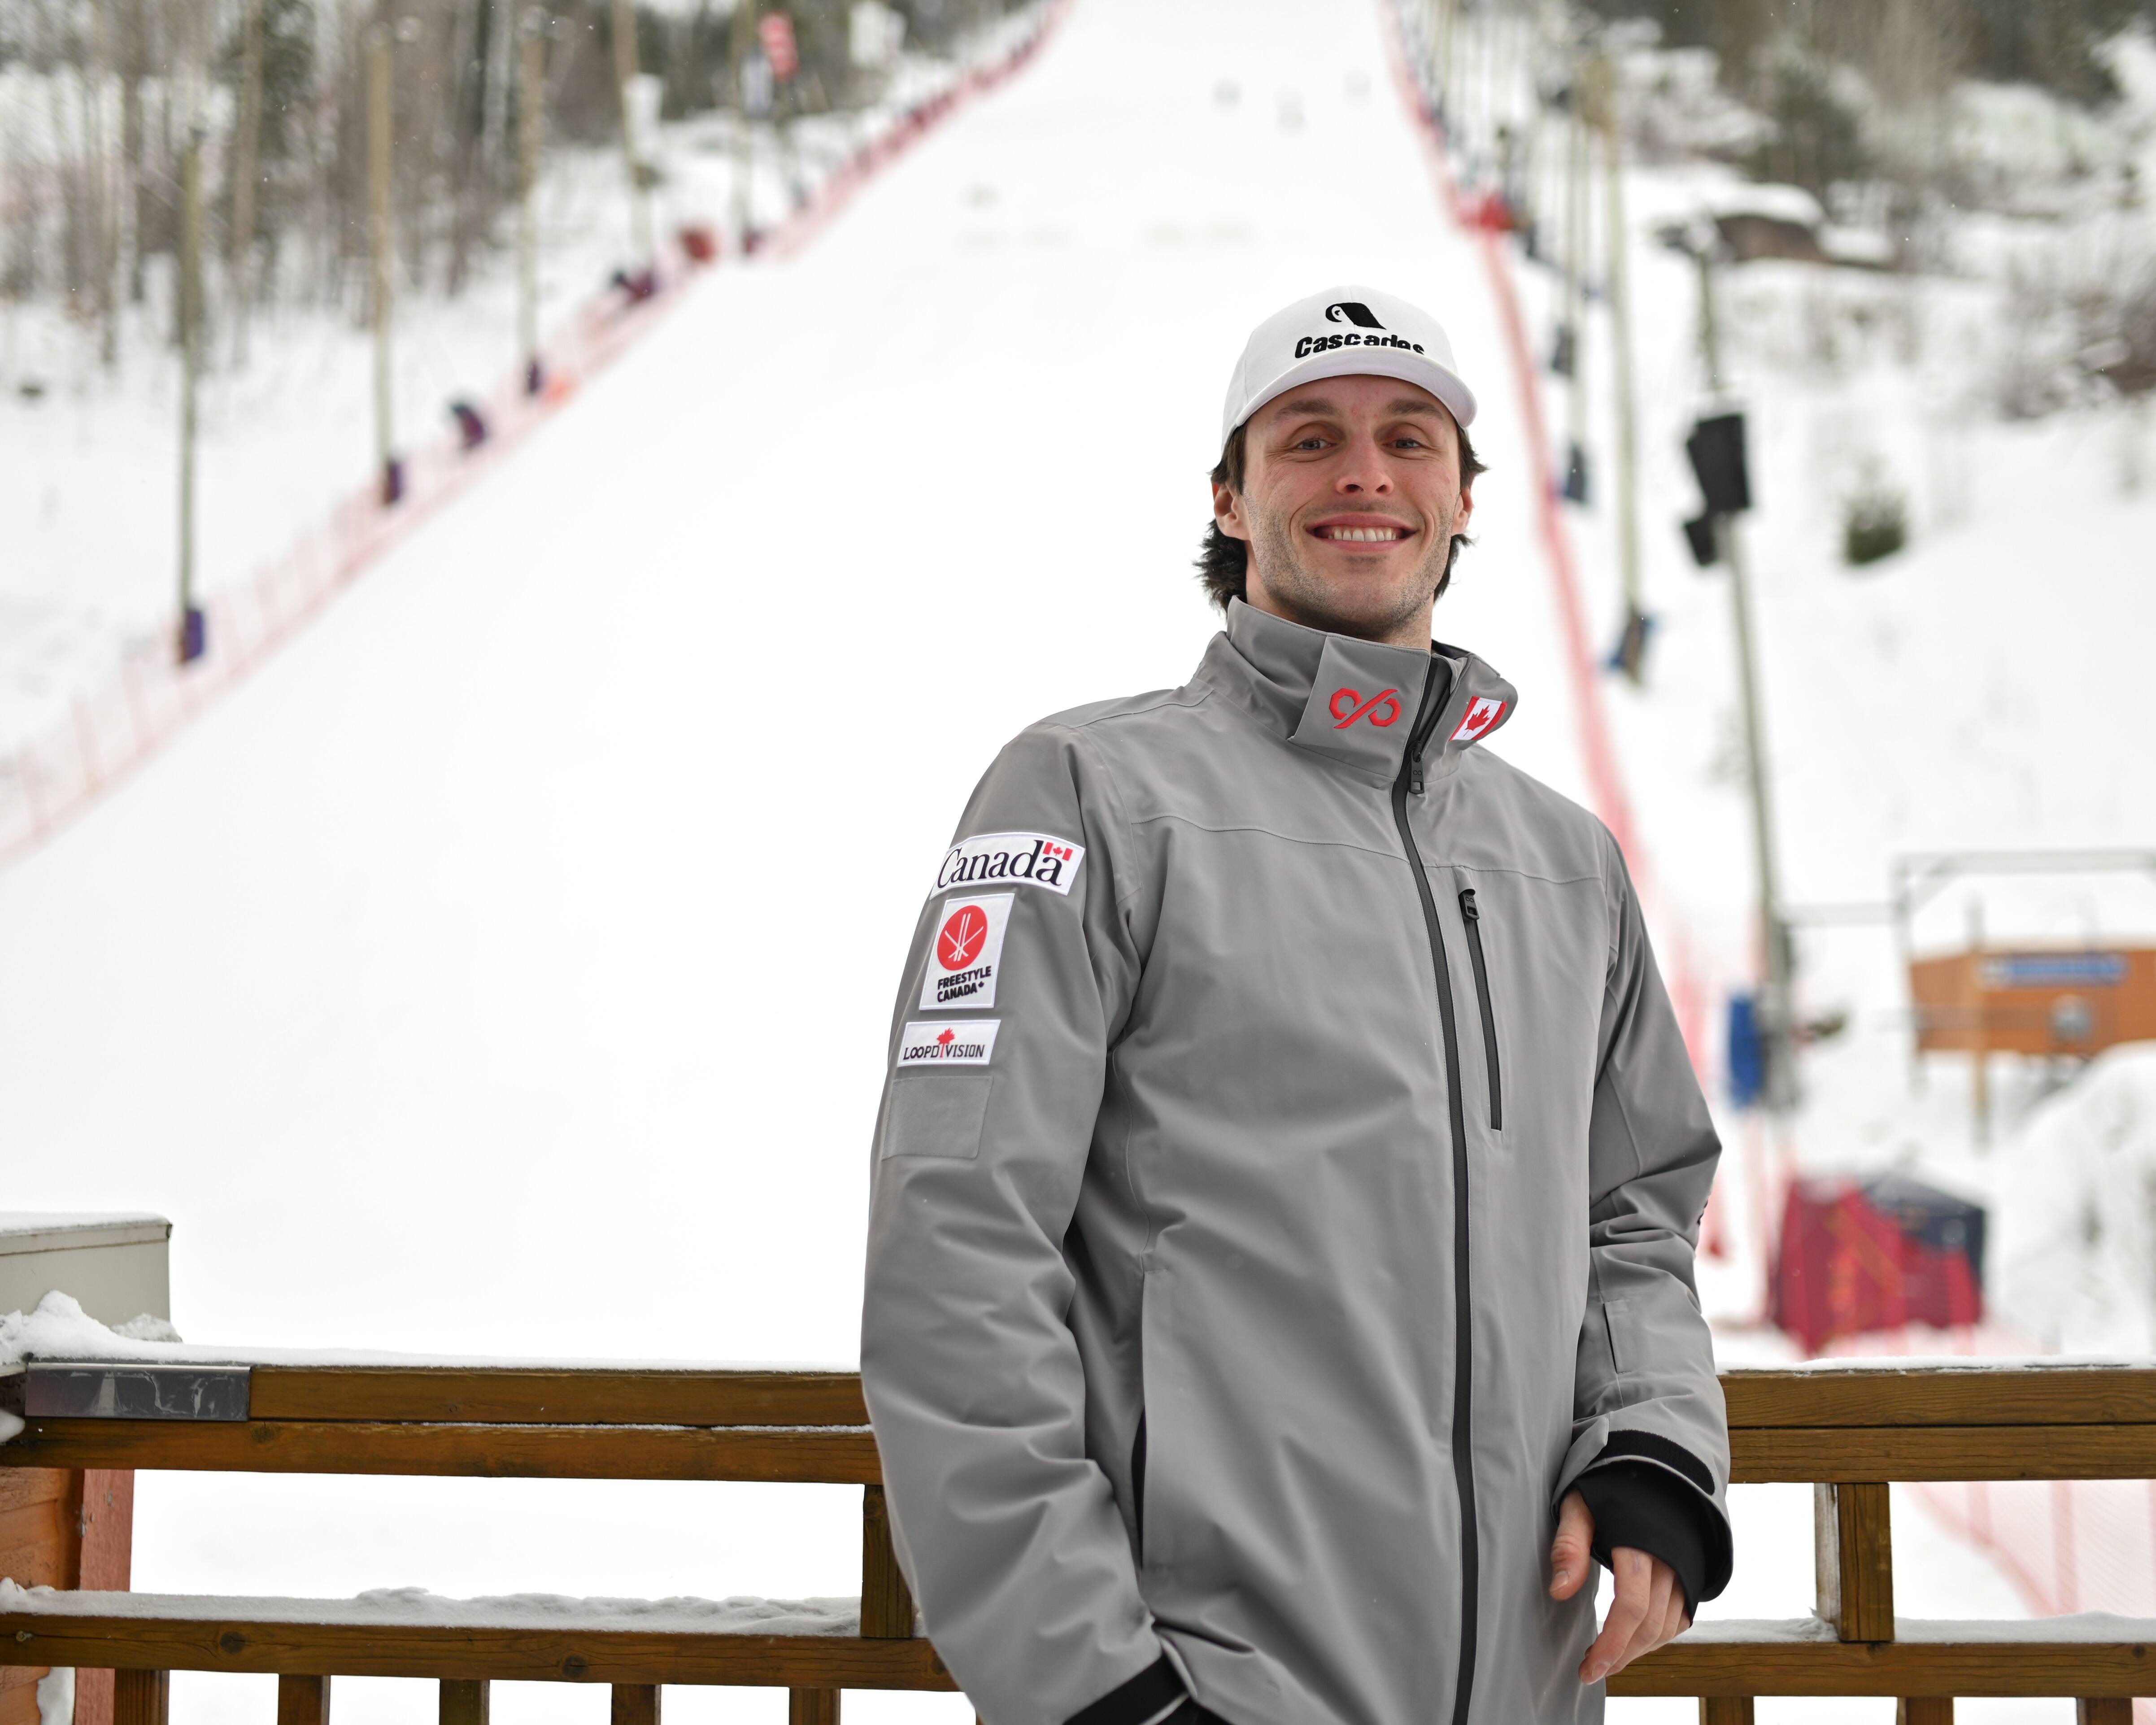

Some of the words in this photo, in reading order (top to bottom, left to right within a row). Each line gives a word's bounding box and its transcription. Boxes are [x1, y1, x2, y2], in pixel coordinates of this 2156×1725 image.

[937, 840, 1062, 889] Canada
[937, 966, 992, 990] FREESTYLE
[937, 983, 978, 1002] CANADA
